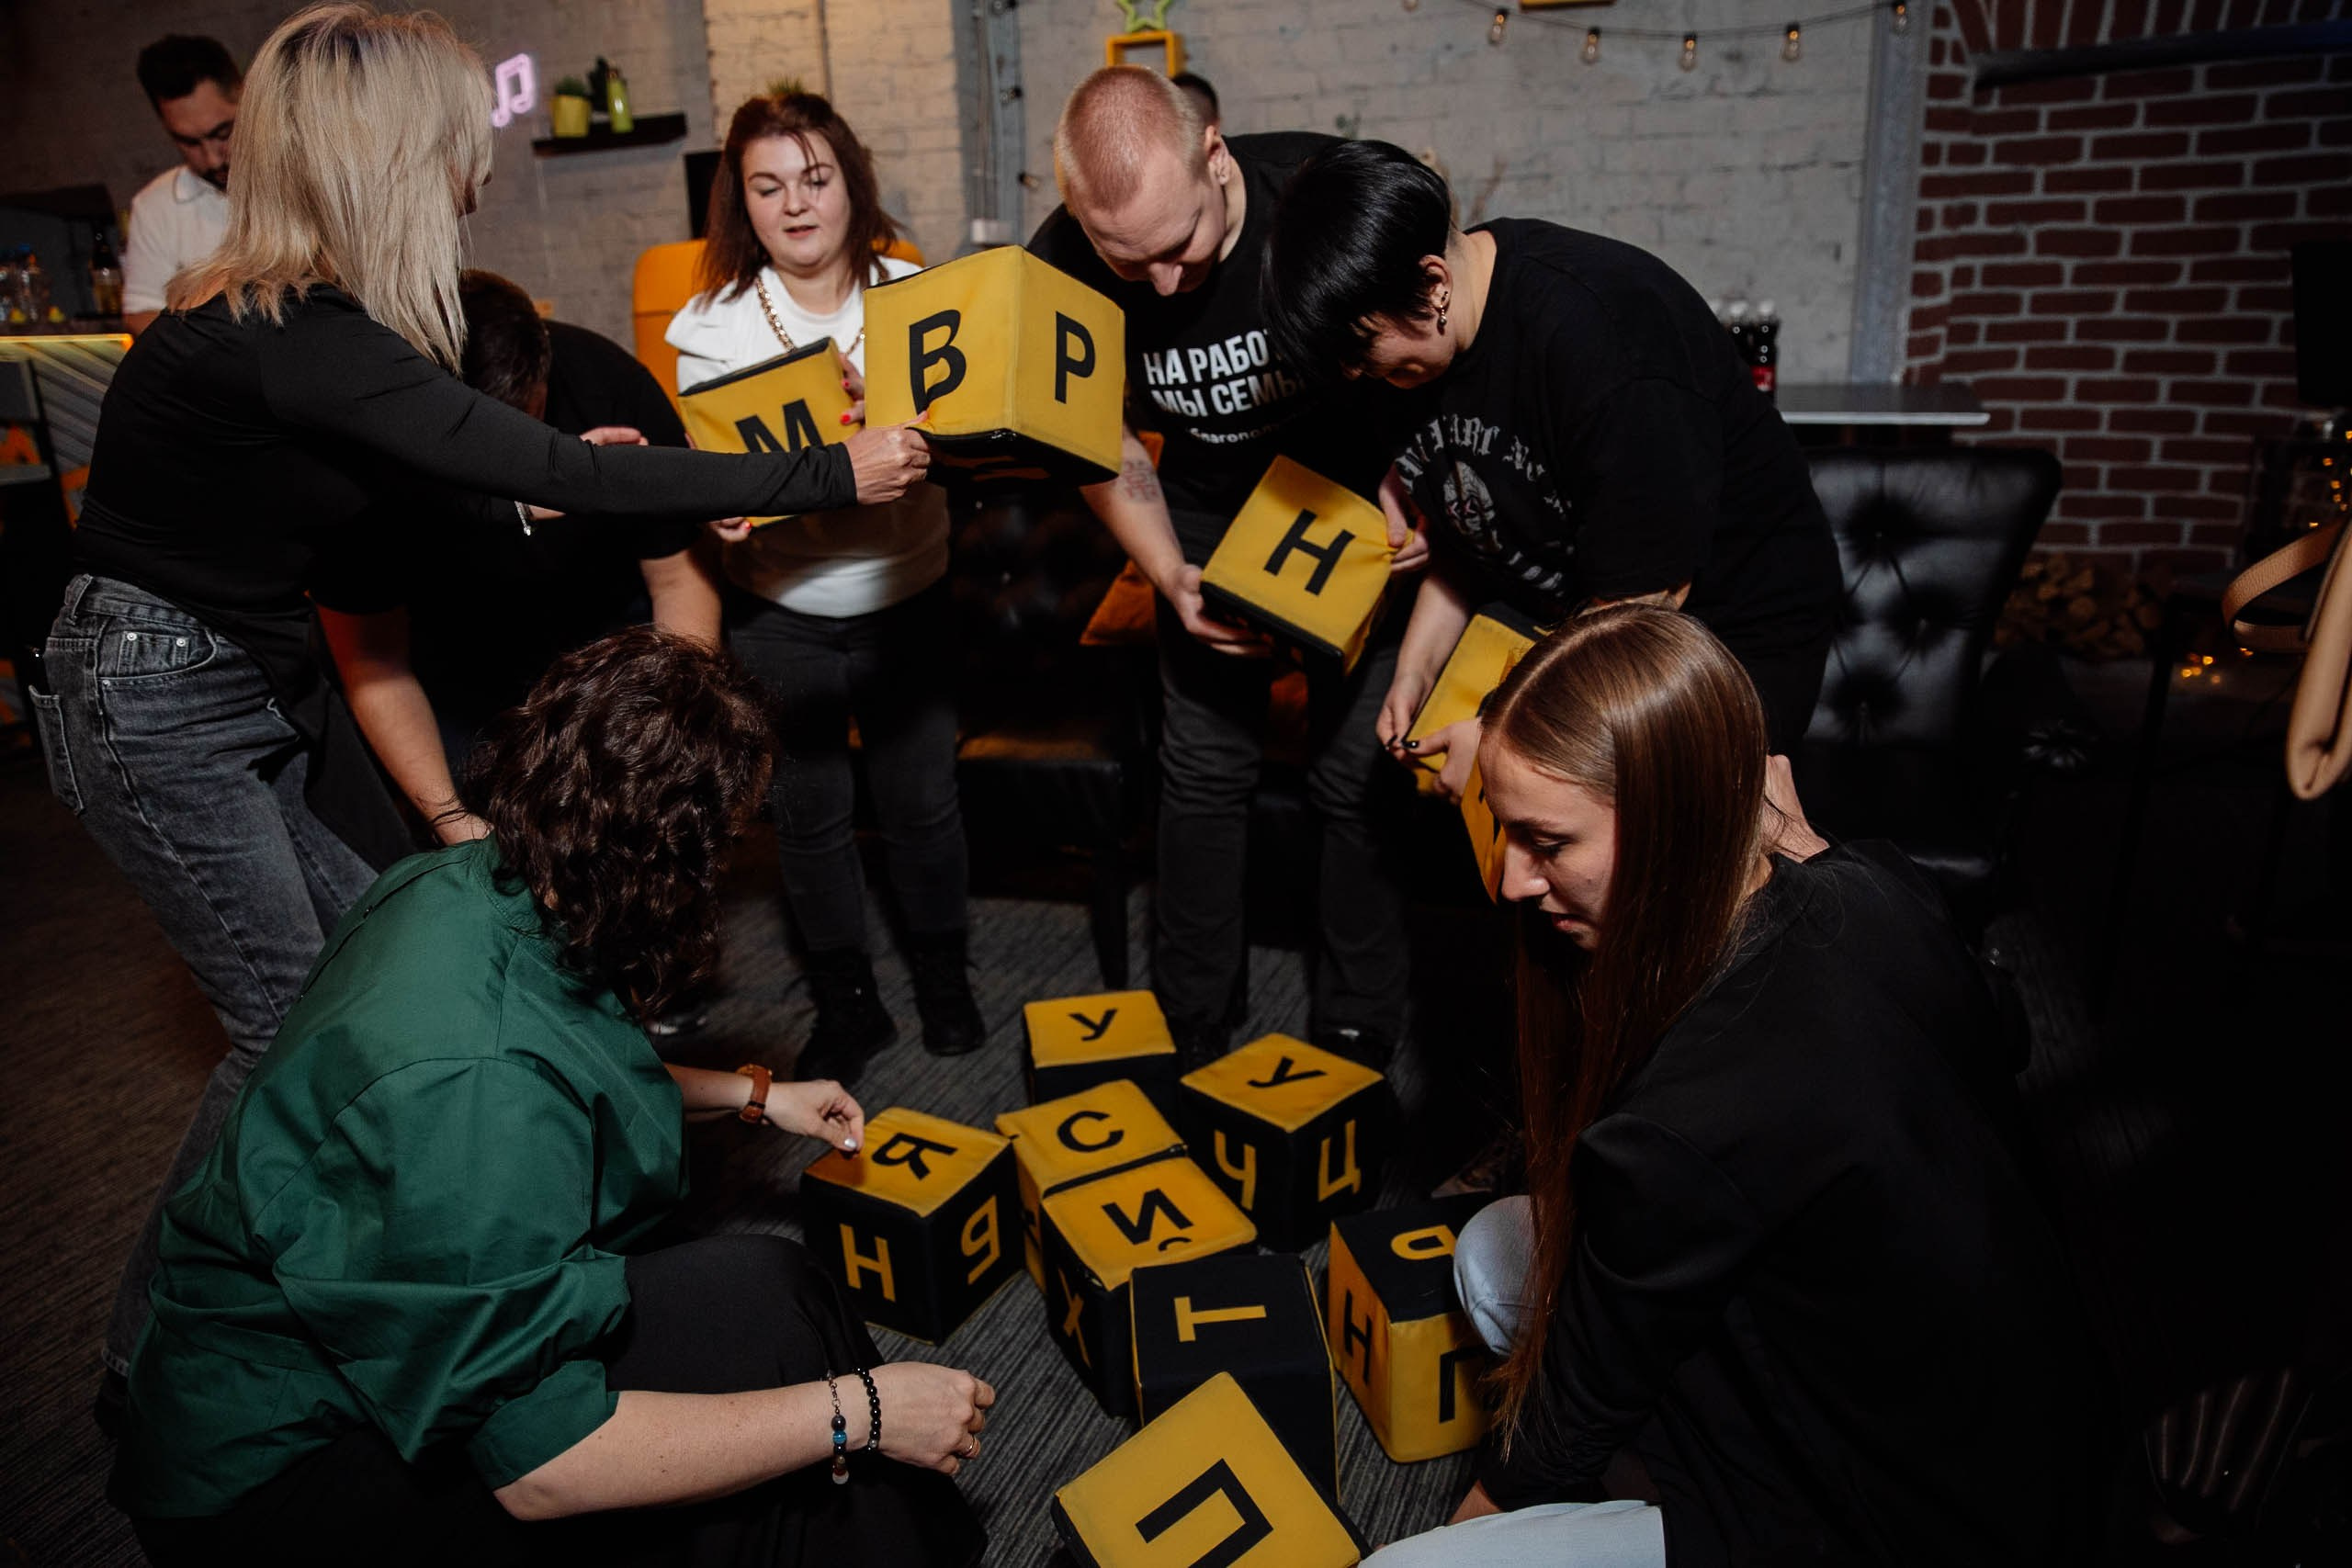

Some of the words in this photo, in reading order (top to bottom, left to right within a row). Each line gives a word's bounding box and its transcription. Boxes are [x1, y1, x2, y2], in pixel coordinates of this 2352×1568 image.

[909, 309, 967, 416] В
[1055, 311, 1096, 404] Р
[1143, 348, 1188, 386] НА
[1186, 328, 1272, 384] РАБО
[1150, 387, 1209, 418] МЫ
[1263, 509, 1356, 596] Н
[1069, 1009, 1118, 1042] У
[1248, 1056, 1327, 1088] У
[1057, 1111, 1125, 1153] С
[1214, 1128, 1257, 1213] Ч
[1317, 1118, 1363, 1204] Ц
[839, 1223, 897, 1304] Н
[1172, 1295, 1268, 1344] Т
[1343, 1287, 1374, 1386] Н
